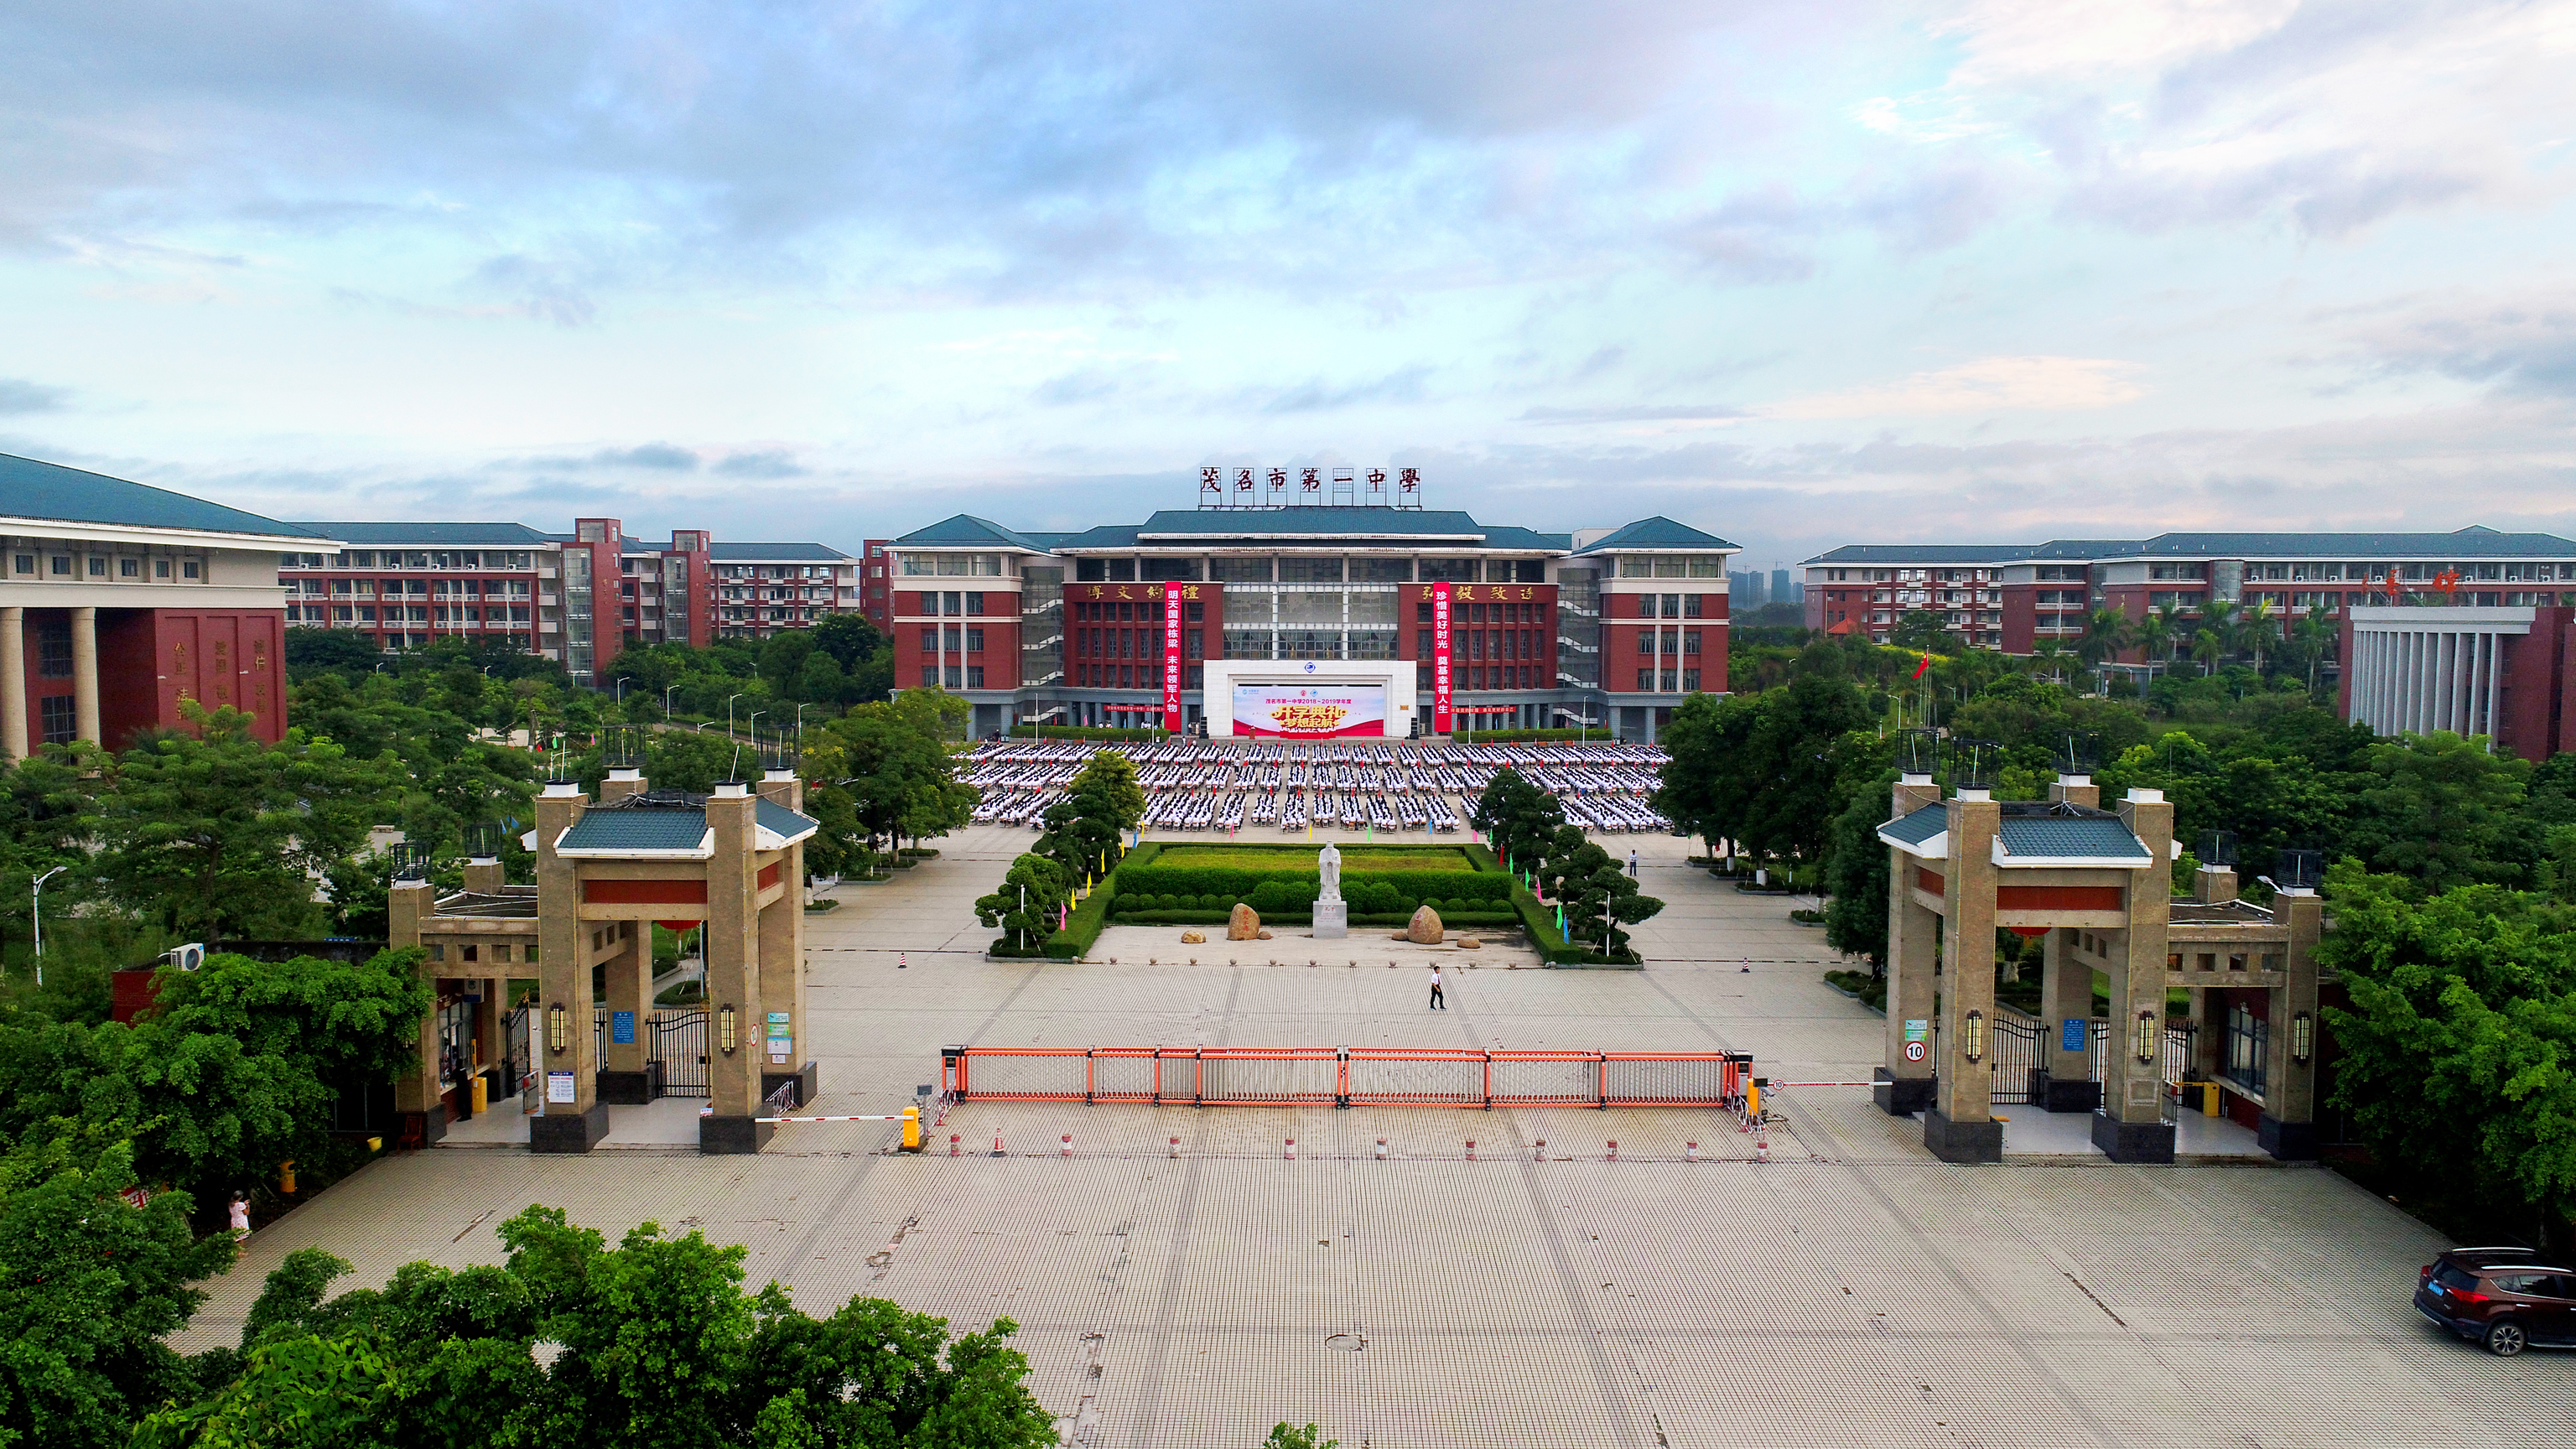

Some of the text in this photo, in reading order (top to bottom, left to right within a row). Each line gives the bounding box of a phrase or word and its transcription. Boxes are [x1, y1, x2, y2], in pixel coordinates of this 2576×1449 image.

[1200, 467, 1420, 493] 茂名市第一中學
[1166, 589, 1179, 713] 明天国家栋梁 未来领军人物
[1436, 590, 1449, 714] 珍惜美好时光 奠基幸福人生
[1270, 705, 1348, 719] 开学典礼
[1285, 718, 1333, 728] 梦想起航
[1909, 1046, 1923, 1057] 10
